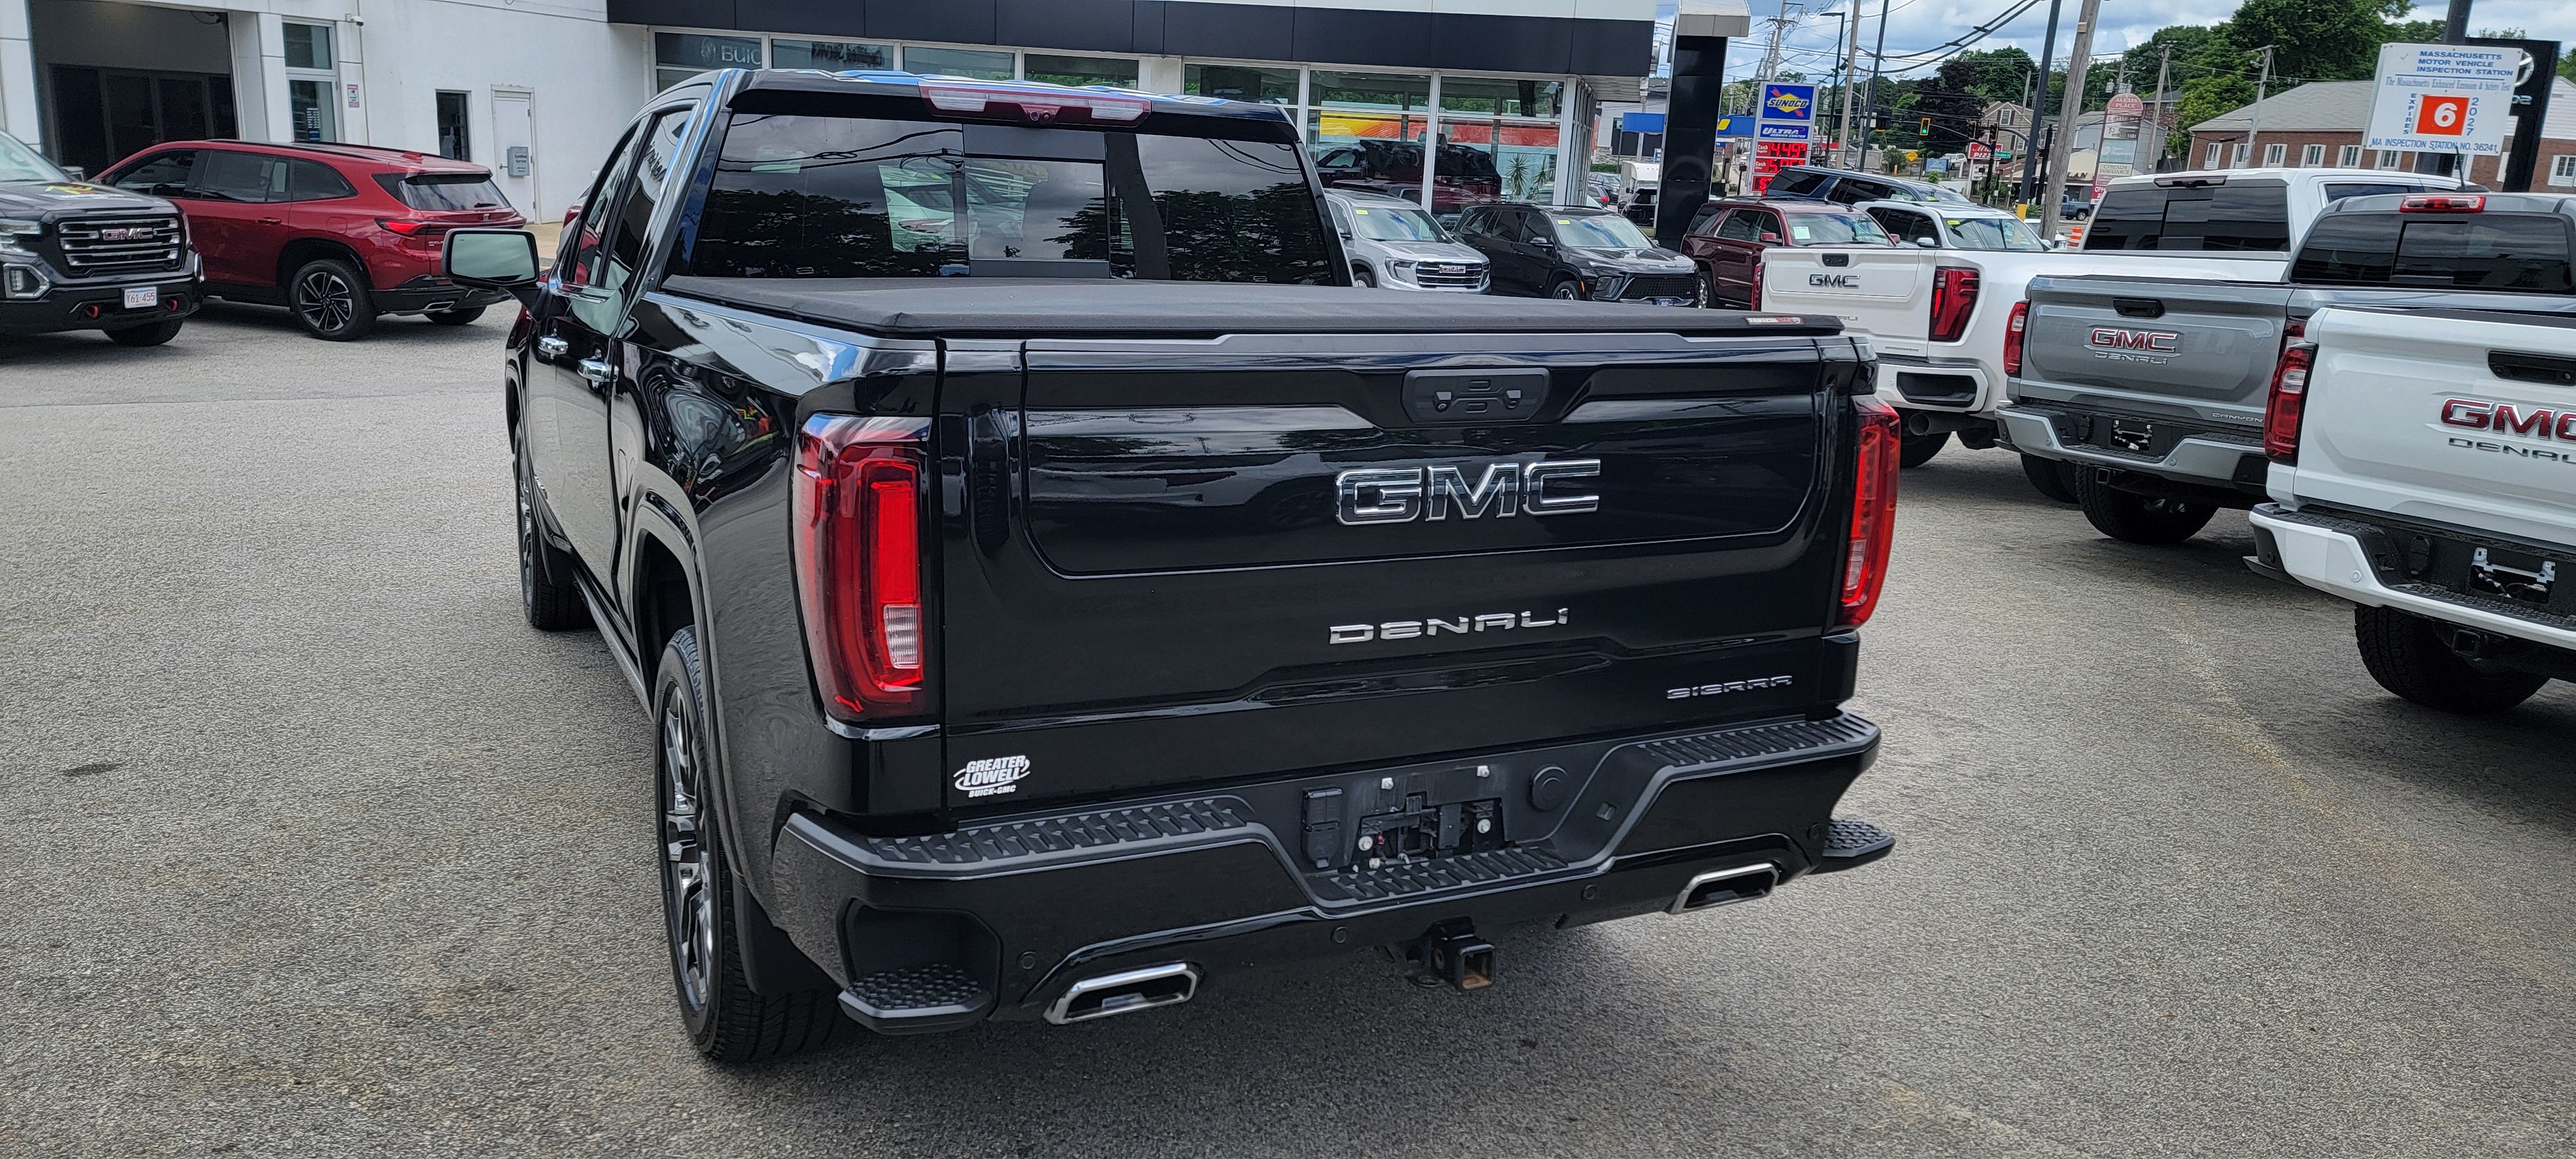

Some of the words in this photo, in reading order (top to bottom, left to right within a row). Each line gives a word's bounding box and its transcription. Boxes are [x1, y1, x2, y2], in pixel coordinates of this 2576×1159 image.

[721, 44, 761, 65] BUIC
[2420, 51, 2502, 60] MASSACHUSETTS
[2385, 77, 2395, 86] The
[2396, 77, 2429, 88] Massachusetts
[2501, 82, 2510, 91] Test
[1768, 99, 1808, 108] SUNOCO
[2403, 93, 2417, 135] EXPIRES
[2434, 102, 2458, 127] 6
[2466, 97, 2479, 137] 2027
[2371, 138, 2382, 146] MA
[2385, 138, 2426, 148] INSPECTION
[2429, 140, 2458, 149] STATION
[2474, 143, 2497, 151] 36241
[102, 227, 153, 241] GMC
[1809, 273, 1861, 288] GMC
[2090, 328, 2179, 353] GMC
[2095, 352, 2168, 365] DENALI
[2212, 413, 2263, 422] CANYON
[2448, 437, 2576, 464] DENAL
[1335, 459, 1601, 525] GMC
[1329, 608, 1568, 645] DENALI
[1666, 675, 1793, 699] SIERRA
[966, 755, 1026, 773] GREATER
[963, 768, 1020, 786] LOWELL
